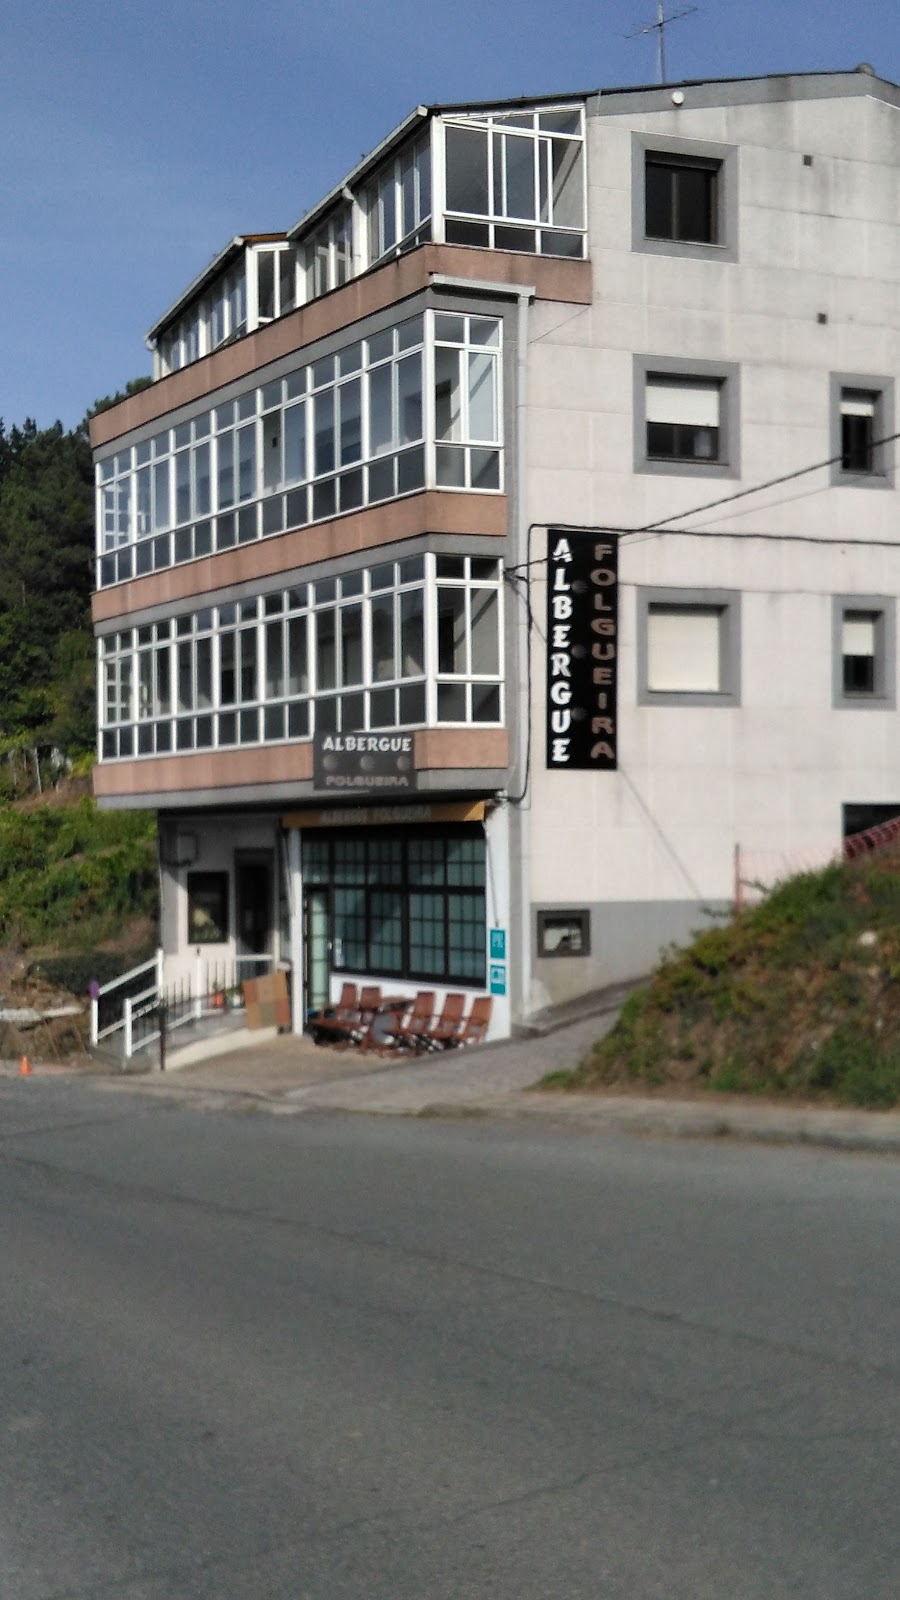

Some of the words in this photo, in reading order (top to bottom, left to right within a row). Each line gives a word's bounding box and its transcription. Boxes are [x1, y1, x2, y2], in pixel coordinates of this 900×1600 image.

[322, 735, 412, 752] ALBERGUE
[550, 538, 573, 763] ALBERGUE
[590, 544, 617, 759] FOLGUEIRA
